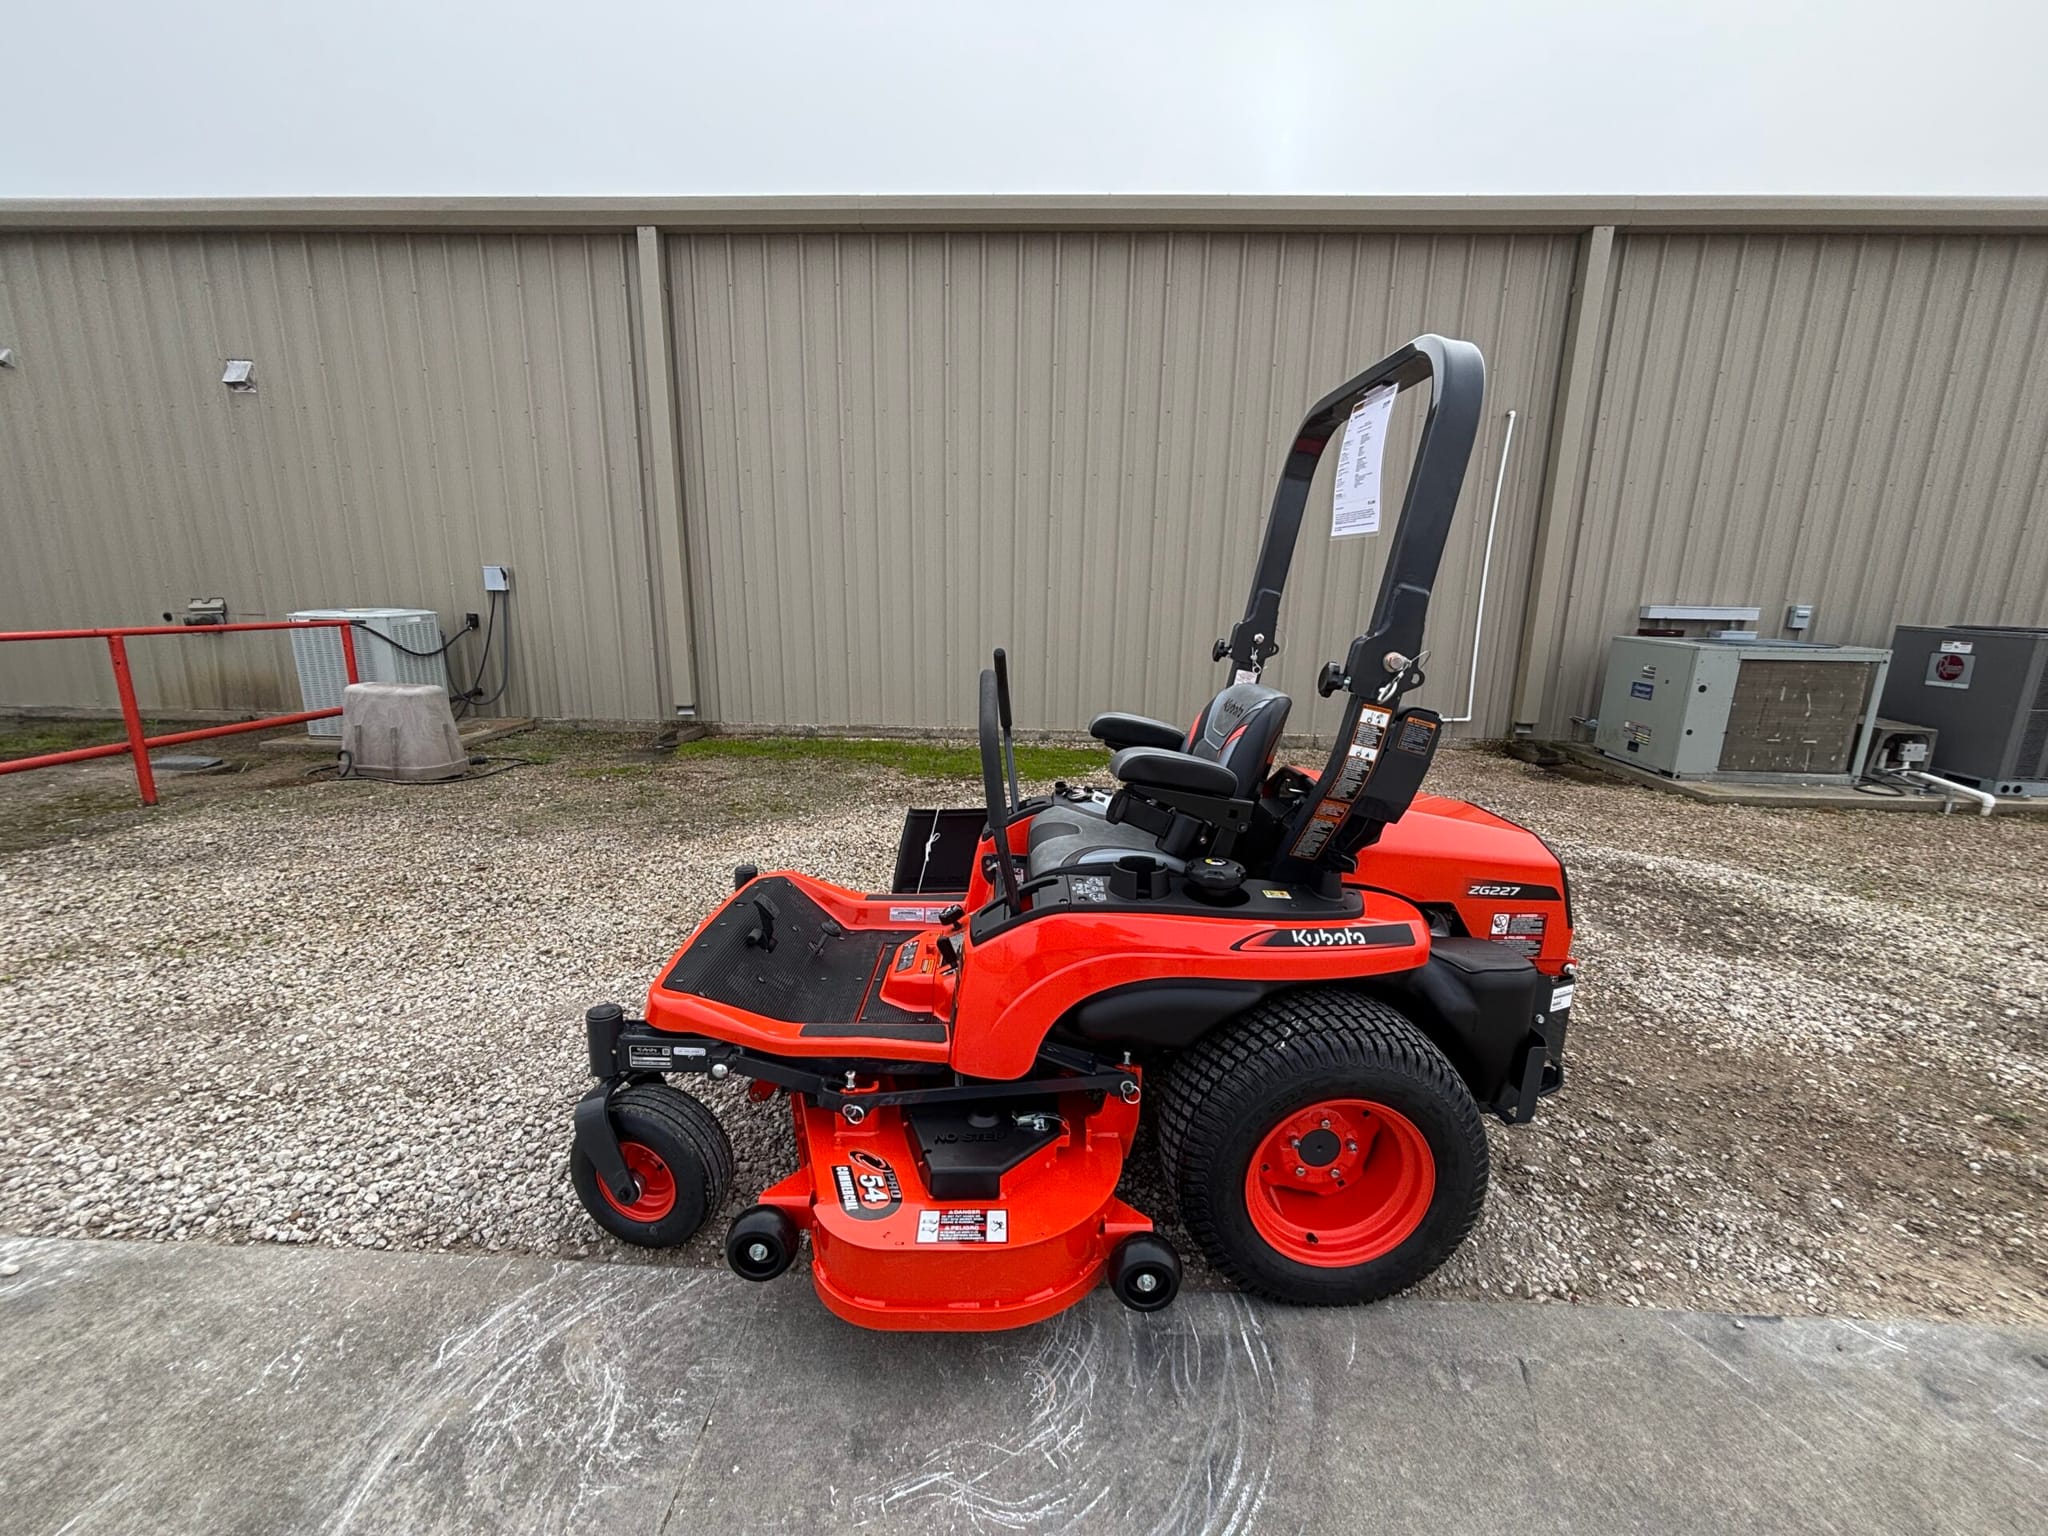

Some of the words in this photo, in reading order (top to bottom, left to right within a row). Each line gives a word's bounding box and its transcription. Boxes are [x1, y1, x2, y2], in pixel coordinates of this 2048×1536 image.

[1467, 885, 1521, 896] ZG227
[1291, 927, 1367, 947] Kubota
[934, 1131, 960, 1144] NO
[835, 1166, 859, 1211] COMMERCIAL
[859, 1174, 889, 1203] 54
[884, 1172, 902, 1199] PRO
